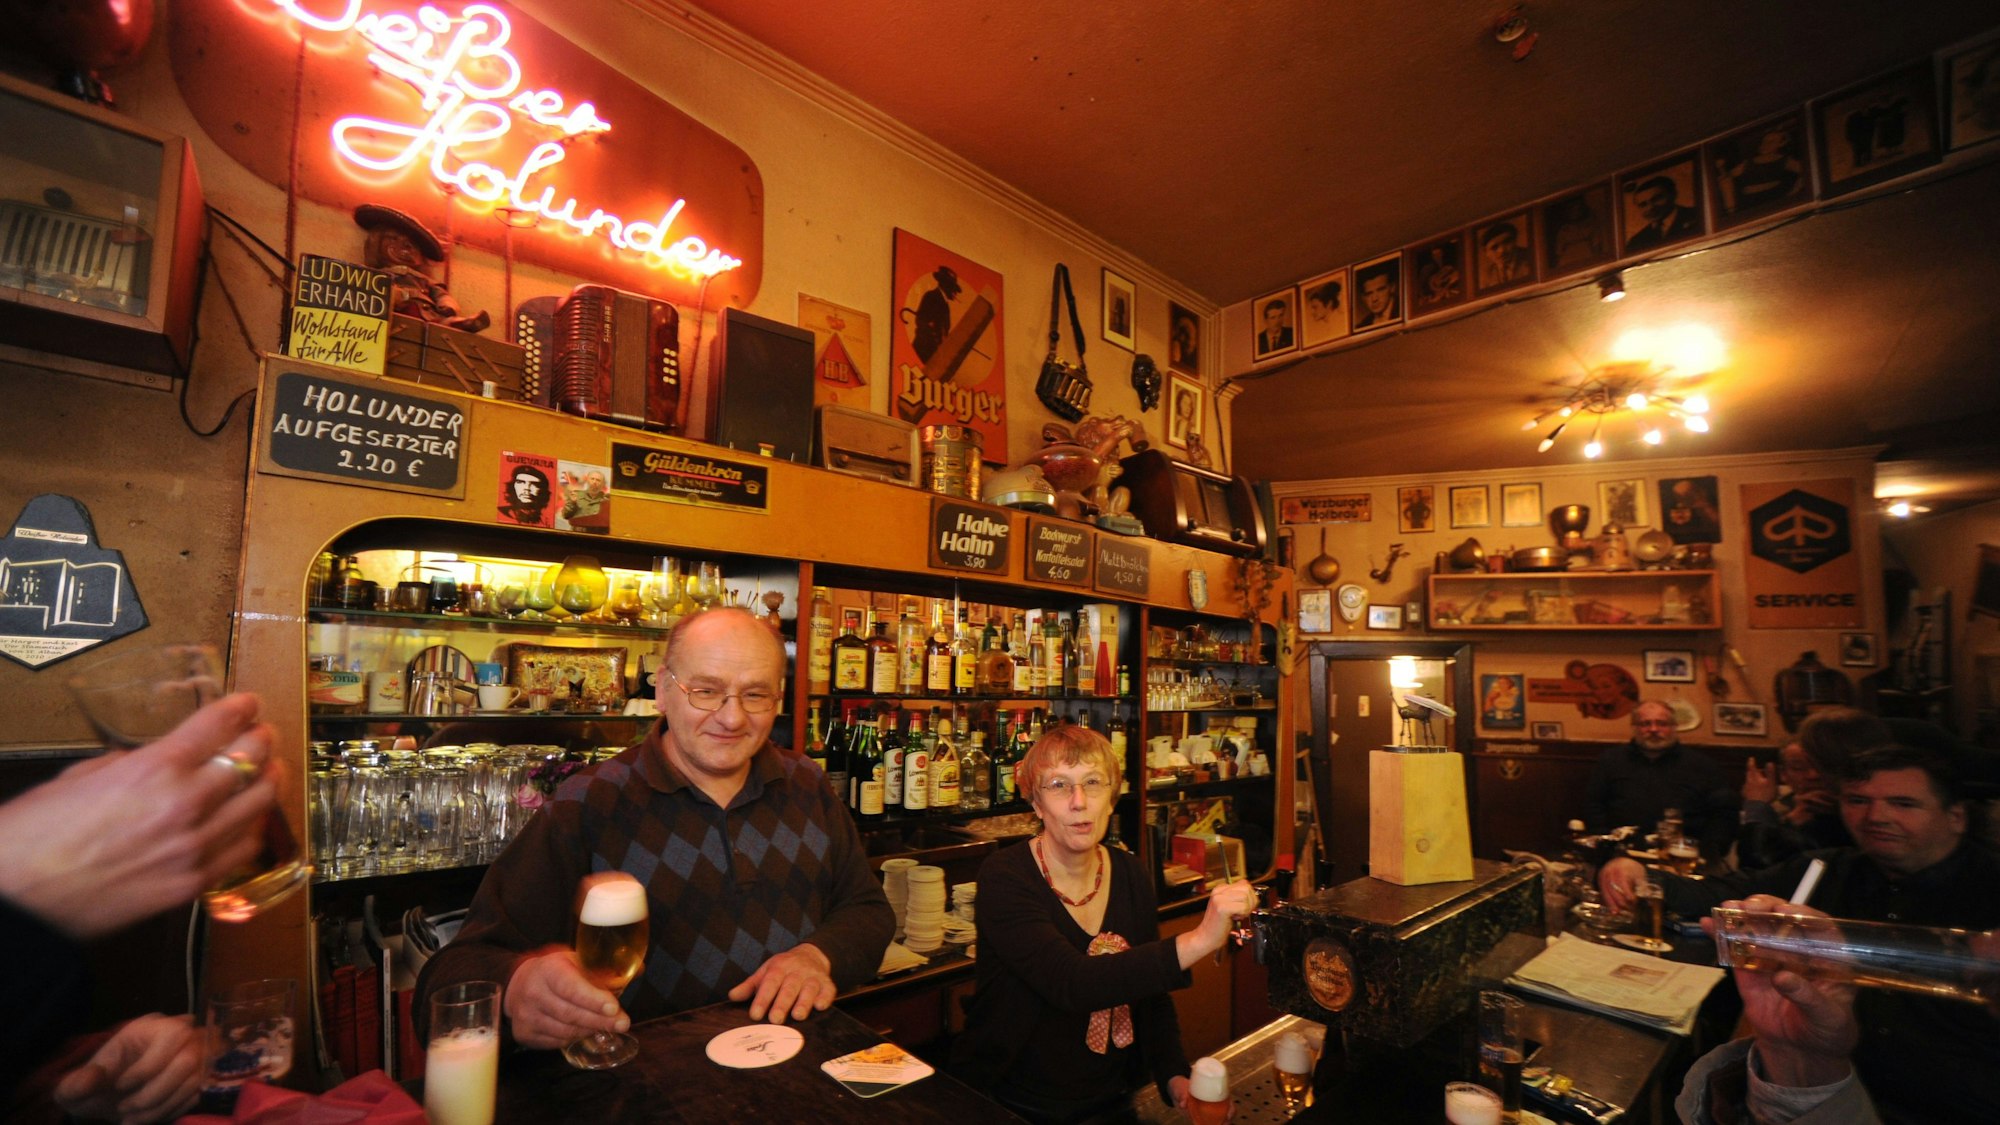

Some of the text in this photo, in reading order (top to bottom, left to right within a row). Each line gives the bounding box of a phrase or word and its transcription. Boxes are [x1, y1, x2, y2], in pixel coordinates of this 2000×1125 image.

[272, 0, 612, 135] eißer
[331, 54, 743, 276] Holunder
[300, 256, 389, 295] LUDWIG
[297, 280, 385, 317] ERHARD
[293, 311, 381, 344] Wohlstand
[296, 336, 368, 365] für Alle
[898, 363, 1005, 425] Burger
[303, 384, 464, 438] HOLUNDER
[273, 413, 458, 460] AUFGESETZTER
[337, 449, 425, 478] 2.20 €
[506, 455, 555, 468] GUEVARA
[956, 512, 1009, 537] Halve
[1039, 526, 1083, 545] Bockwurst
[940, 531, 995, 556] Hahn
[1051, 543, 1067, 554] mit
[1755, 593, 1856, 607] SERVICE
